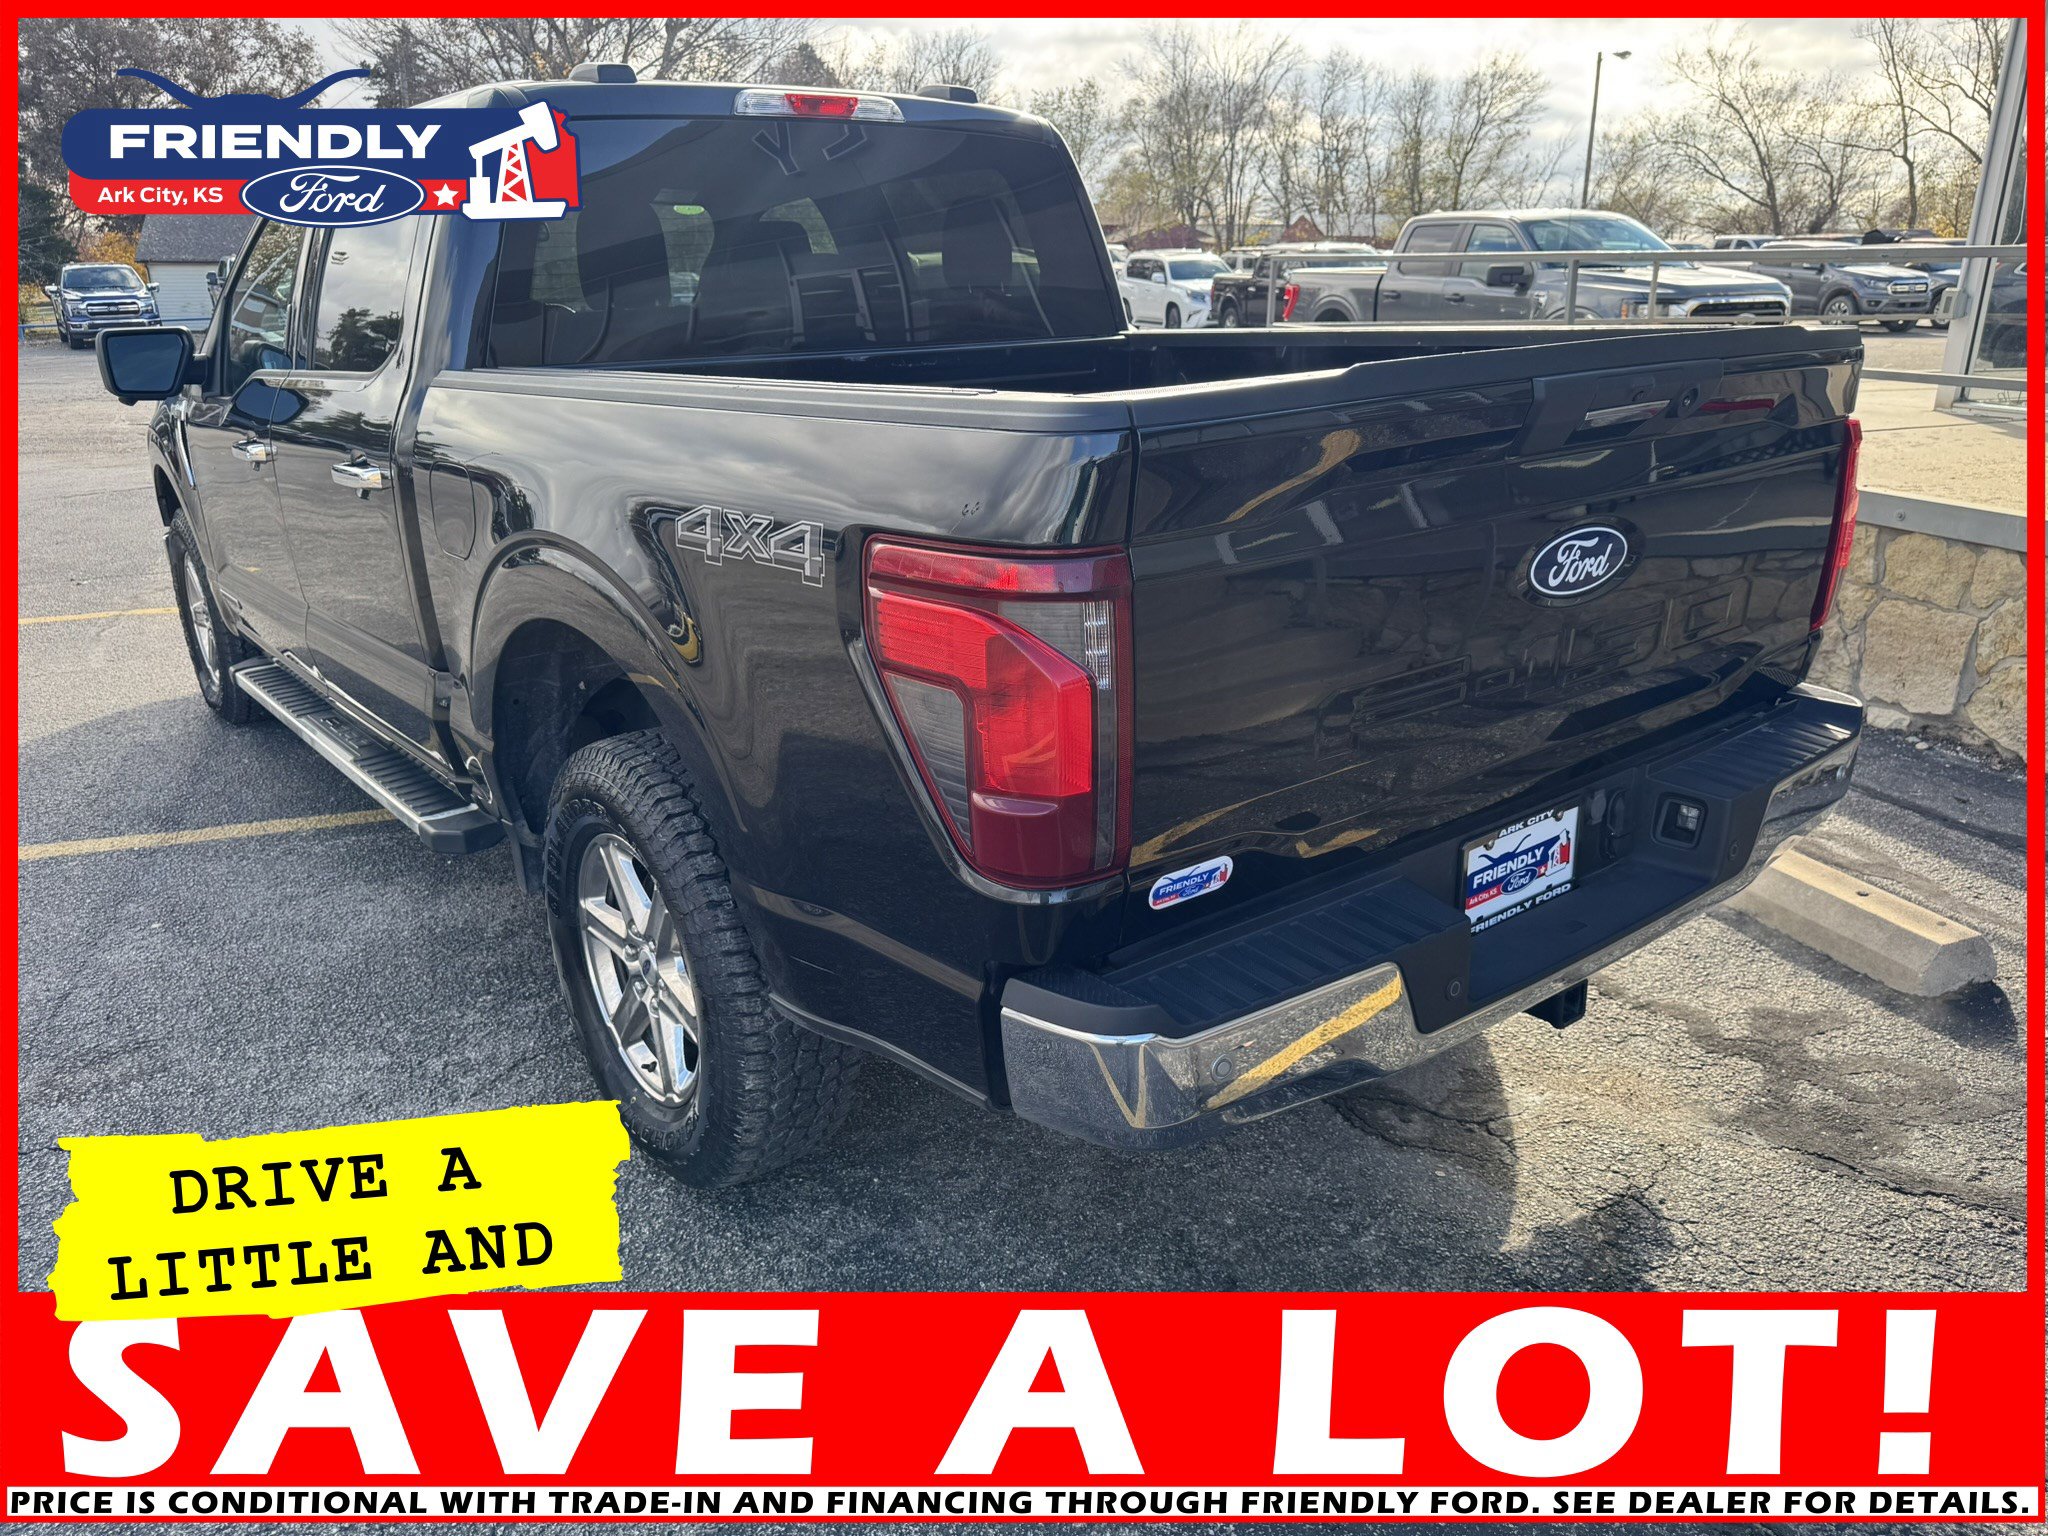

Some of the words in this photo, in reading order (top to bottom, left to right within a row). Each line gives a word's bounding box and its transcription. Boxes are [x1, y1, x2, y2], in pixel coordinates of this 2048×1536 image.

[1548, 536, 1613, 587] Ford
[1499, 823, 1524, 838] ARK
[1527, 809, 1555, 826] CITY
[1473, 846, 1545, 889] FRIENDLY
[1159, 872, 1210, 896] FRIENDLY
[1507, 871, 1532, 891] Ford
[1536, 883, 1572, 905] FORD
